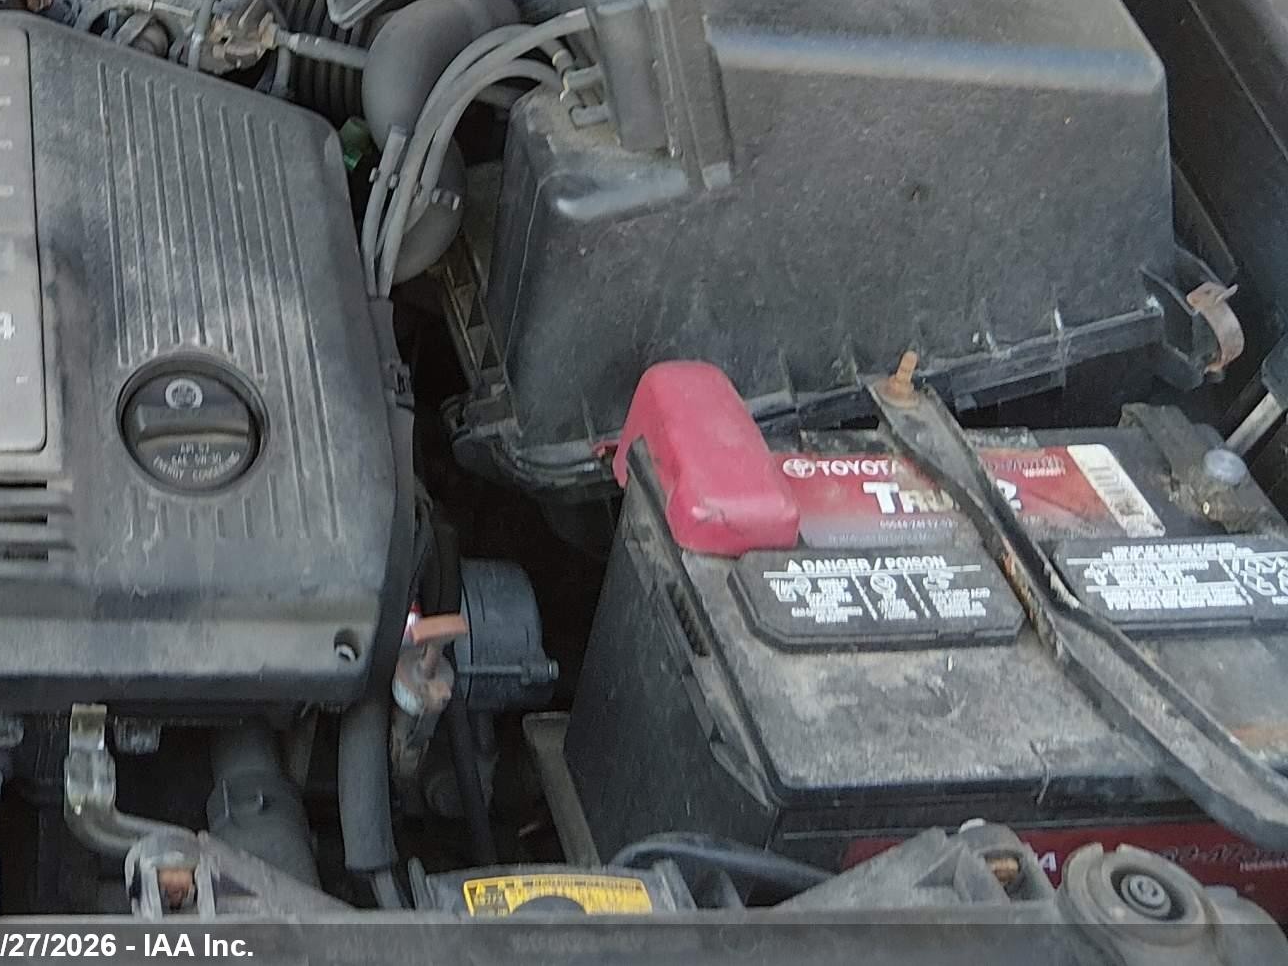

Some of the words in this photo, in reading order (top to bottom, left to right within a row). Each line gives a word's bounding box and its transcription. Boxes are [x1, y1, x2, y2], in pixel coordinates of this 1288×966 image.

[815, 459, 896, 476] TOYOT
[801, 558, 872, 573] DANGER
[884, 555, 948, 571] POISON
